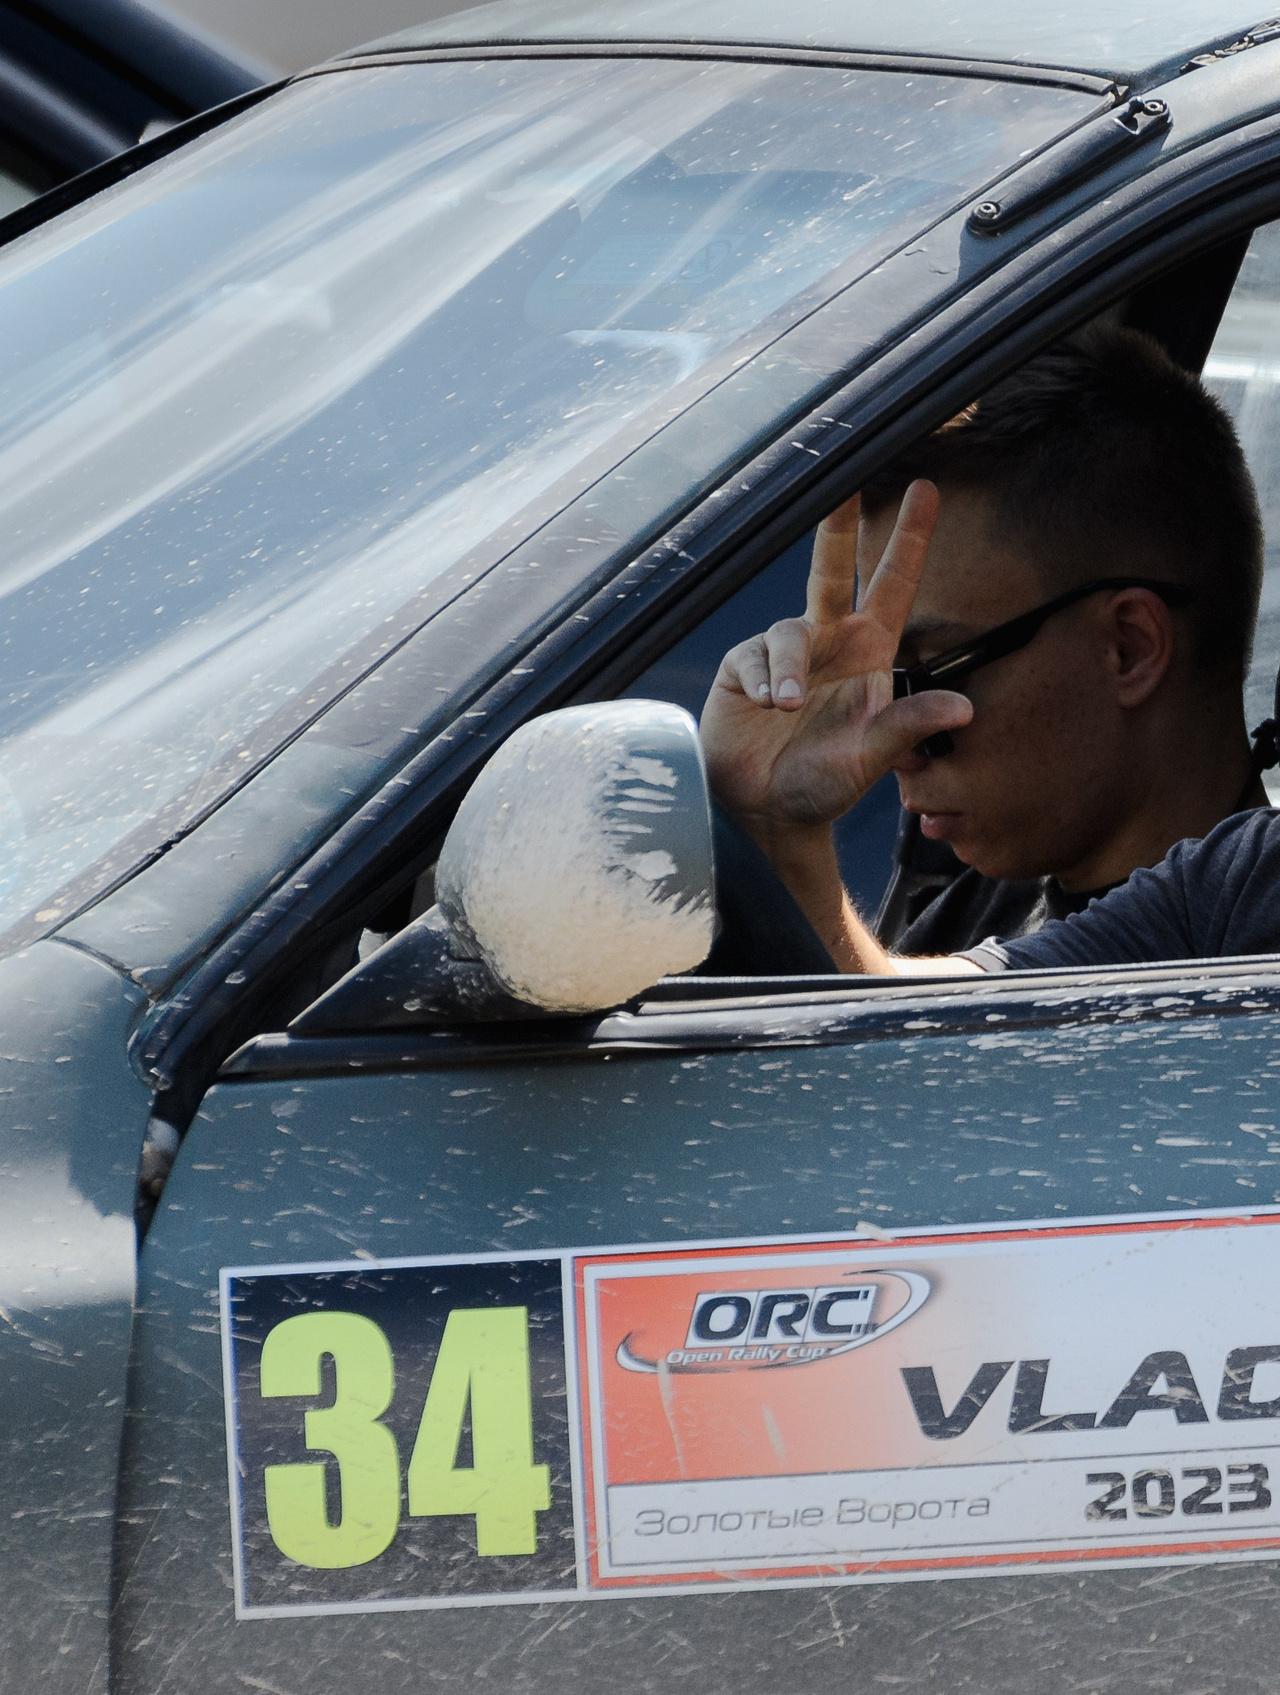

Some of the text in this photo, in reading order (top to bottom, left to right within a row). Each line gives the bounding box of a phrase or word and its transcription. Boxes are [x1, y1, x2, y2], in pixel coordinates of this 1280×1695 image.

[666, 1343, 827, 1366] Open Rally Cup
[260, 1305, 551, 1570] 34
[634, 1496, 992, 1537] Золотые Ворота
[1085, 1463, 1272, 1522] 2023
